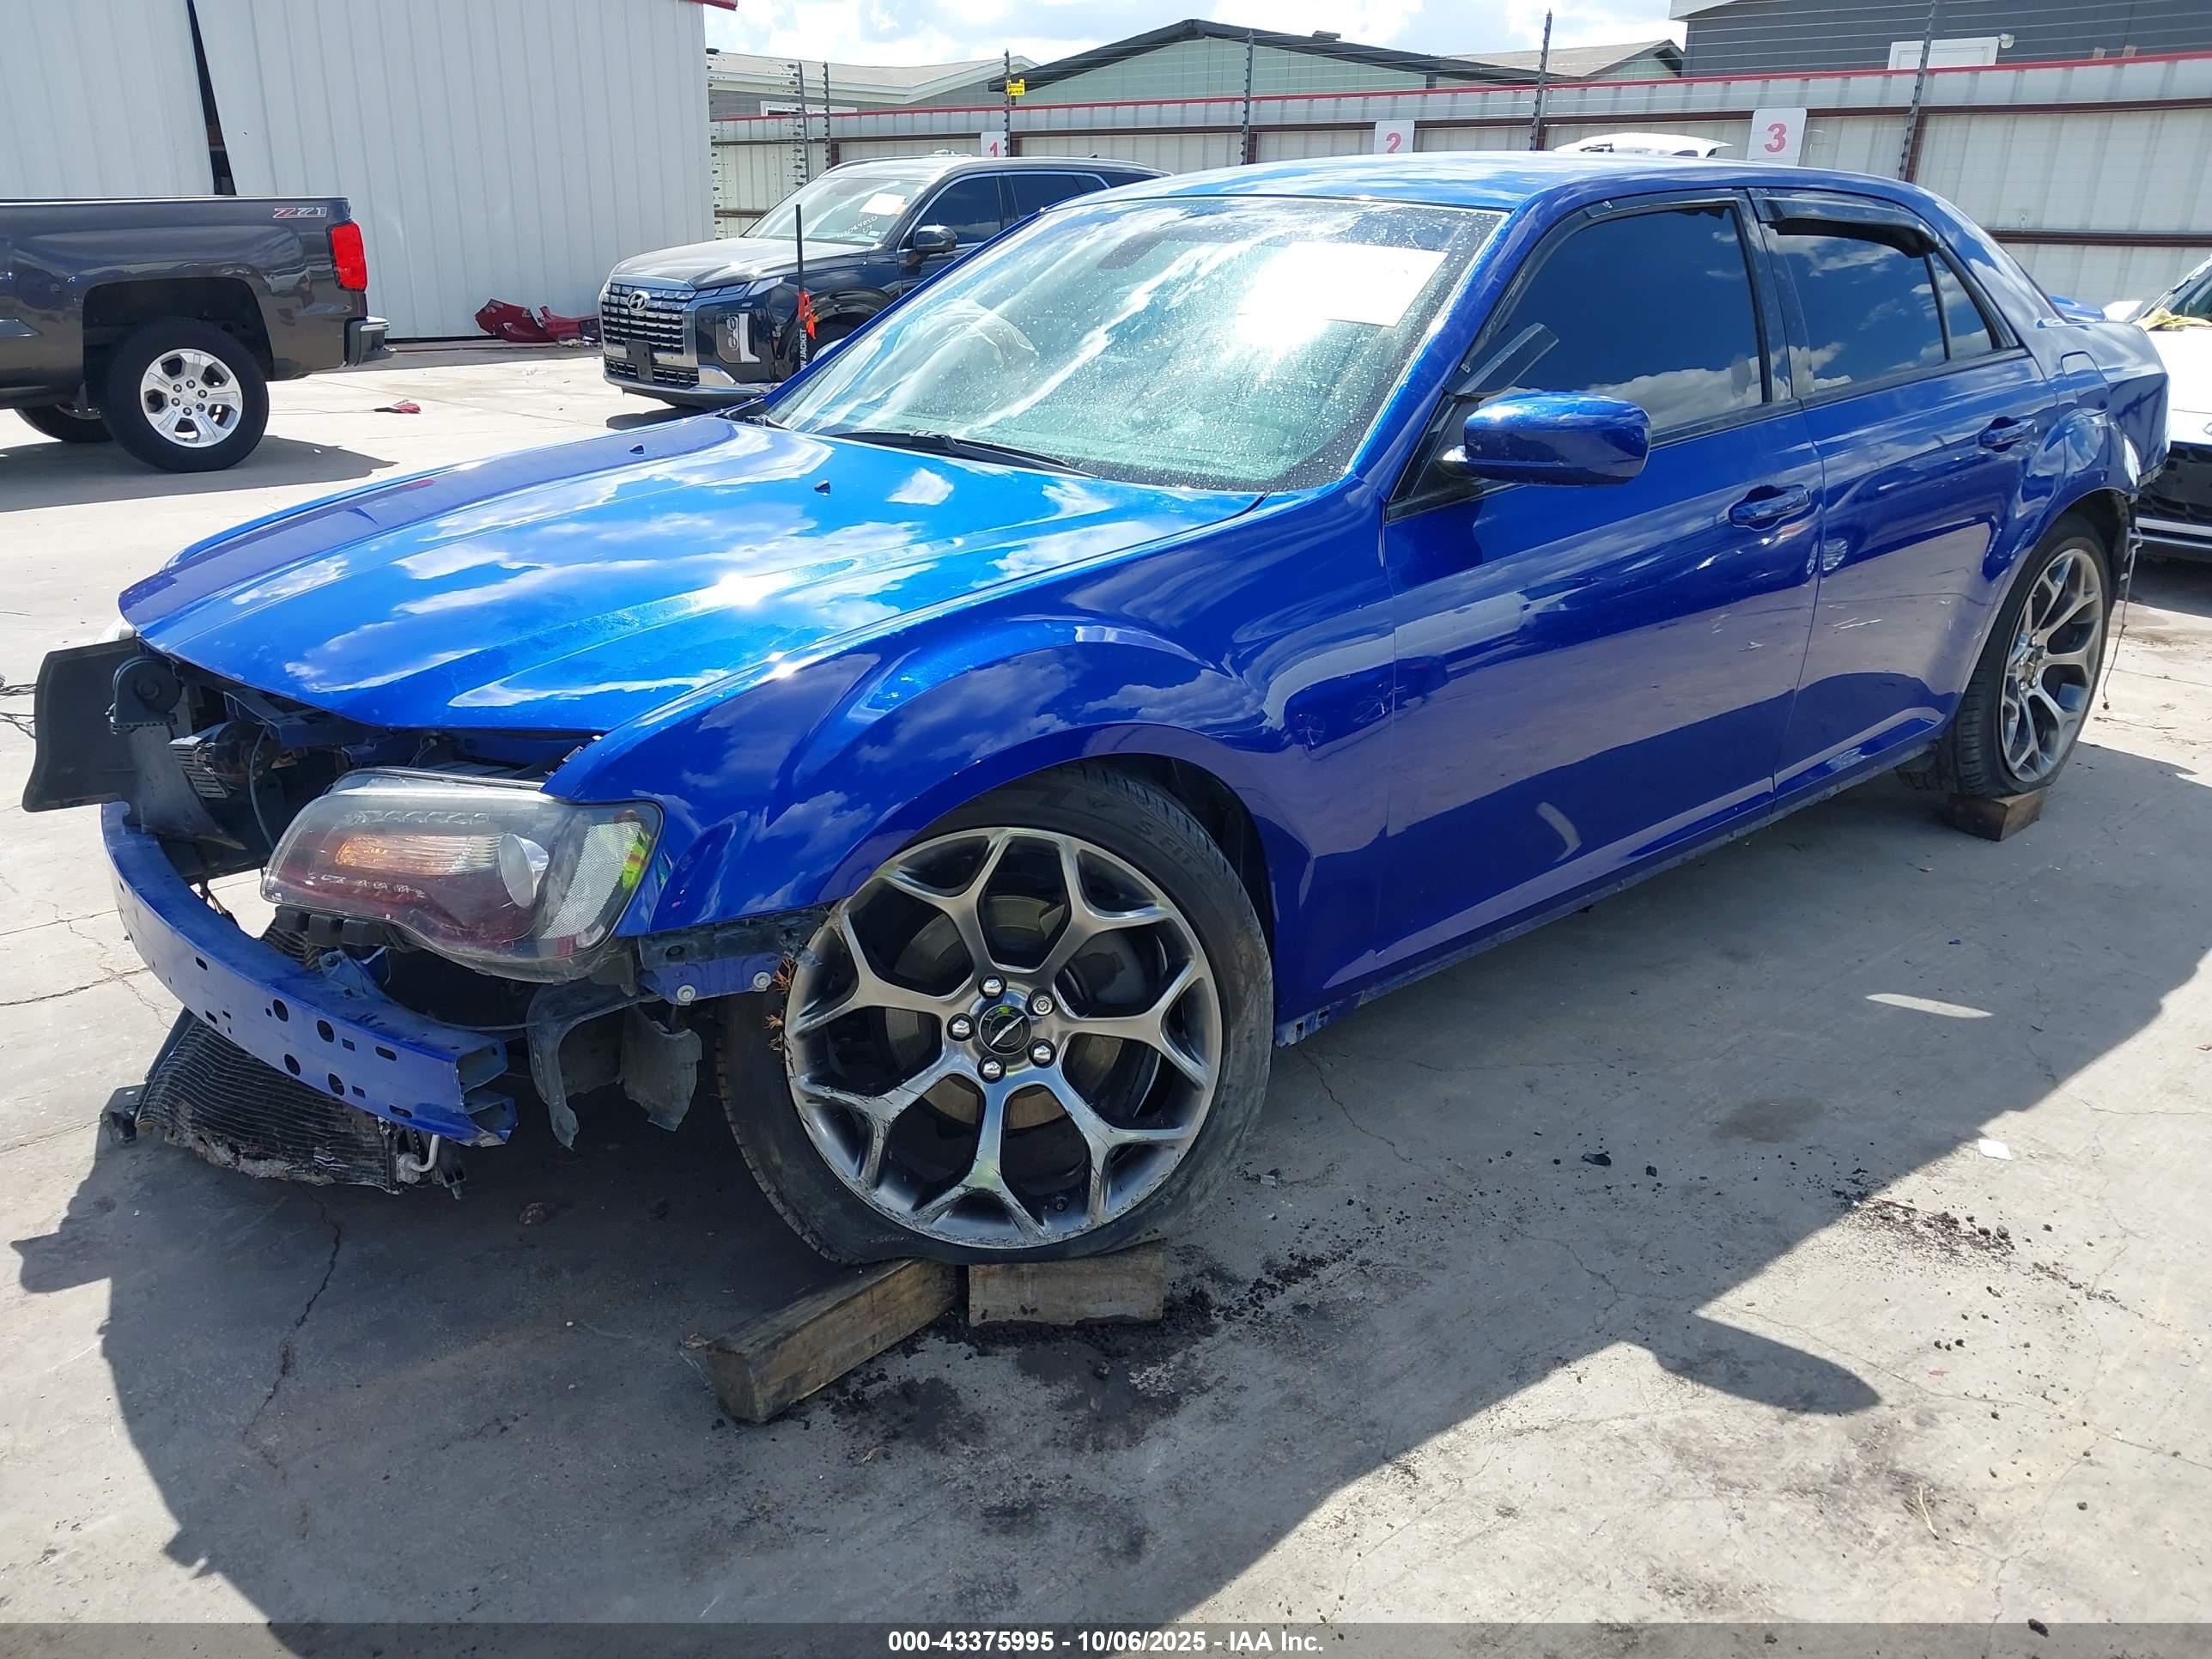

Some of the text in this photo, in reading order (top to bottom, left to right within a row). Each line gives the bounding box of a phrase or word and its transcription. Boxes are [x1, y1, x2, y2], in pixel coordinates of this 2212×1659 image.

[1386, 132, 1402, 154] 2
[1764, 123, 1787, 153] 3
[989, 142, 998, 157] 1
